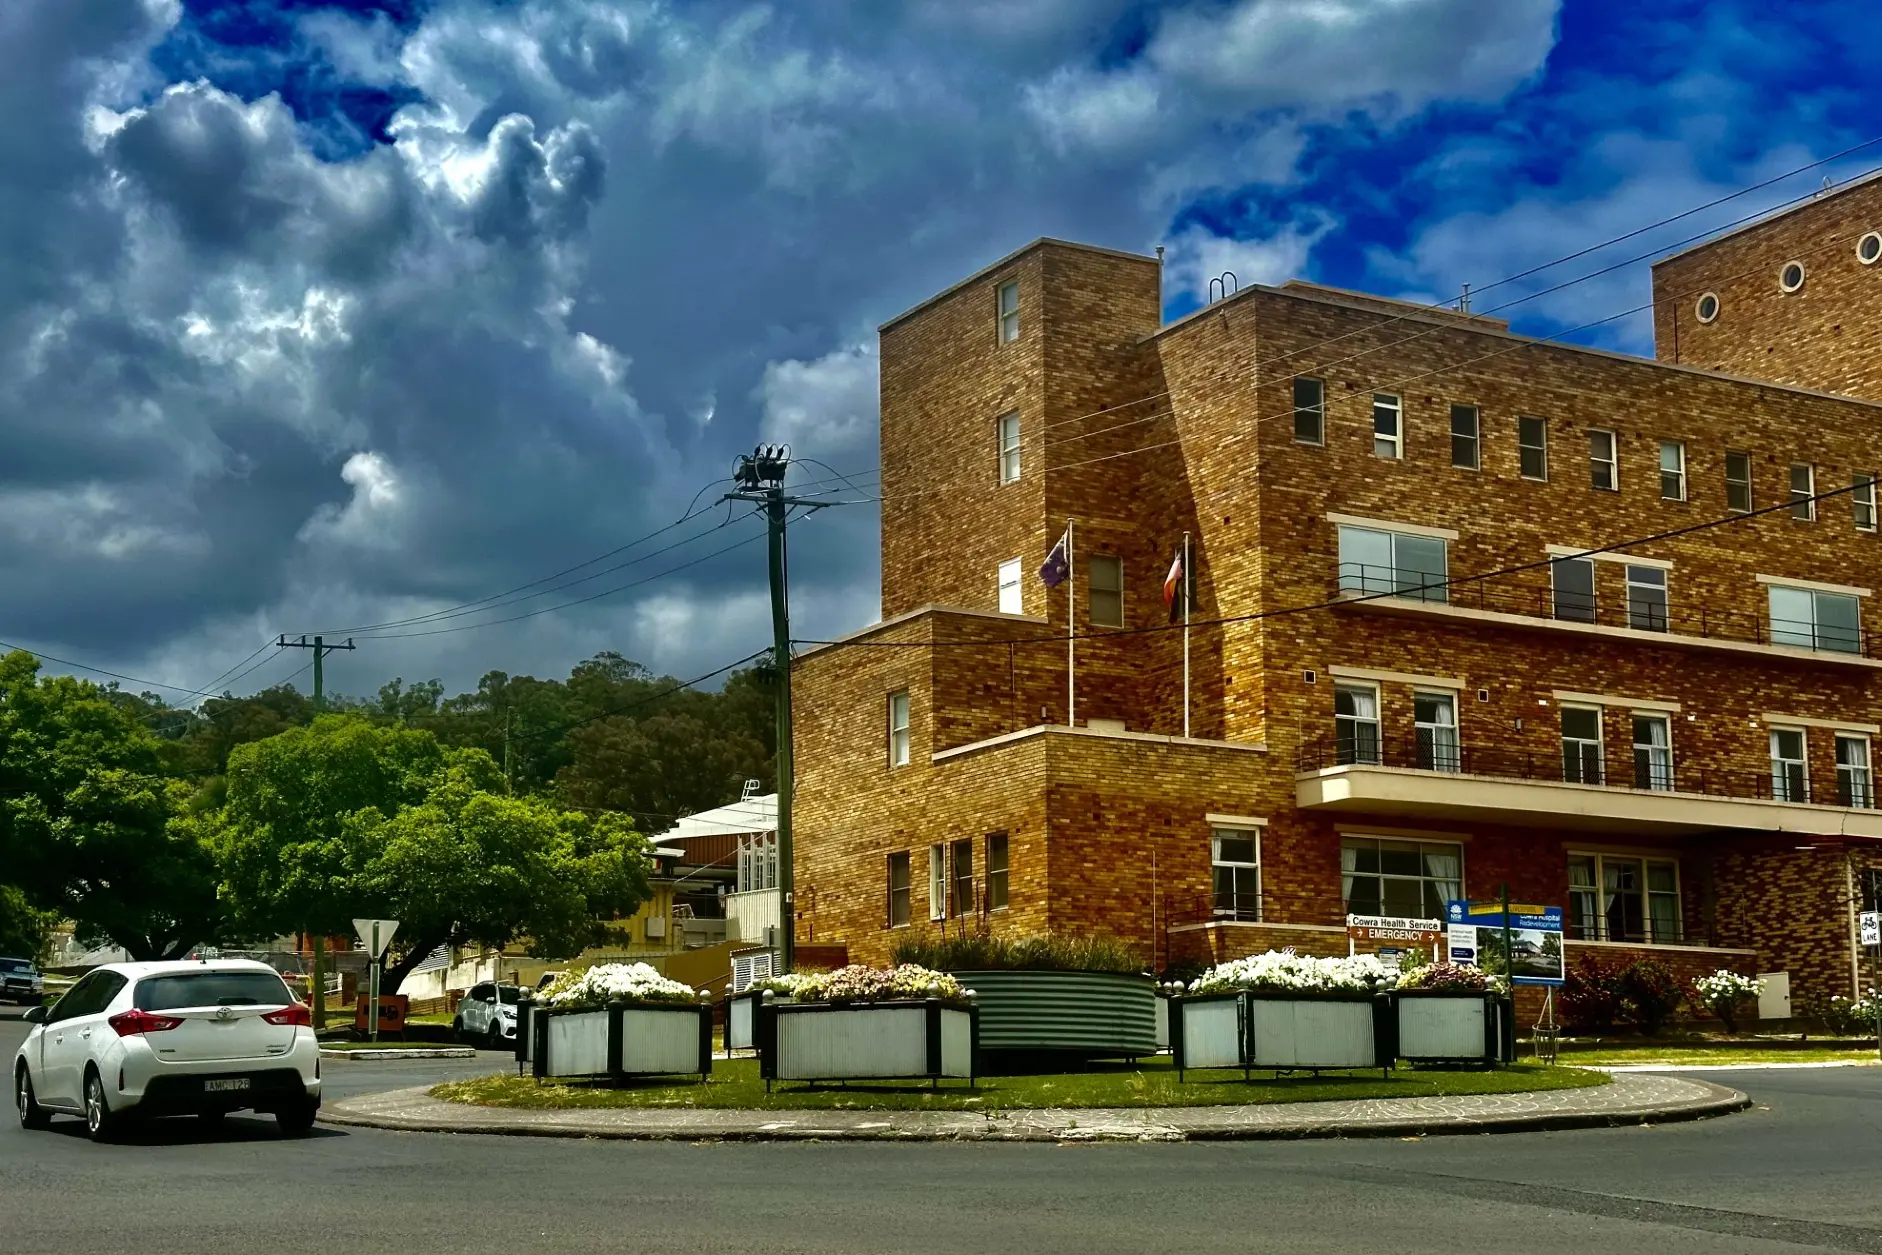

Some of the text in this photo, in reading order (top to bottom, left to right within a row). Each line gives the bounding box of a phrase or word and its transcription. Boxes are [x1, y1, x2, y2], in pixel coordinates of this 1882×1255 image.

[1352, 916, 1438, 930] Cowra Health Service
[1520, 920, 1561, 929] Redevelopment
[1368, 928, 1423, 941] EMERGENCY
[1863, 933, 1877, 942] LANE
